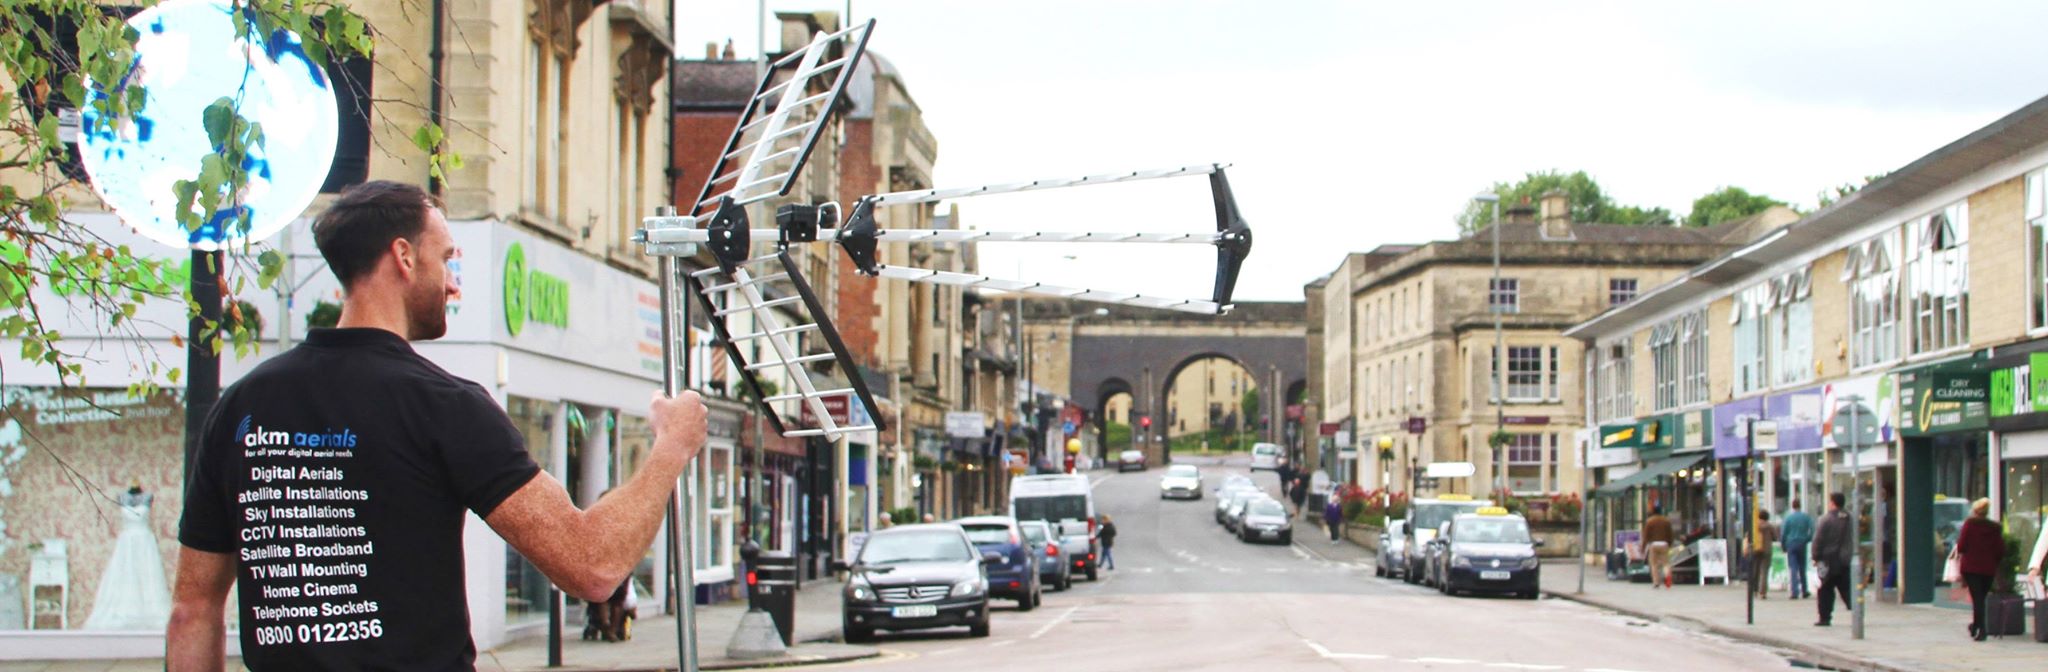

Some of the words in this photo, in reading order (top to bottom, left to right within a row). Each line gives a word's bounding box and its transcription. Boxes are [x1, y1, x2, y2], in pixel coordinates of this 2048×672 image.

[1951, 379, 1969, 387] DRY
[1937, 389, 1985, 398] CLEANING
[245, 426, 289, 447] akm
[294, 428, 357, 447] aerials
[245, 449, 256, 457] for
[257, 448, 266, 456] all
[288, 449, 312, 458] digital
[314, 449, 334, 457] aerial
[251, 466, 295, 482] Digital
[299, 467, 343, 480] Aerials
[239, 487, 282, 503] atellite
[286, 486, 368, 500] Installations
[245, 507, 268, 522] Sky
[271, 505, 355, 518] Installations
[241, 525, 275, 541] CCTV
[280, 524, 366, 538] Installations
[240, 544, 291, 561] Satellite
[295, 541, 373, 557] Broadband
[250, 565, 265, 579] TV
[268, 563, 297, 578] Wall
[301, 562, 367, 577] Mounting
[263, 585, 299, 598] Home
[304, 583, 357, 596] Cinema
[253, 605, 317, 621] Telephone
[321, 600, 378, 616] Sockets
[256, 625, 293, 645] 0800
[298, 619, 383, 643] 0122356
